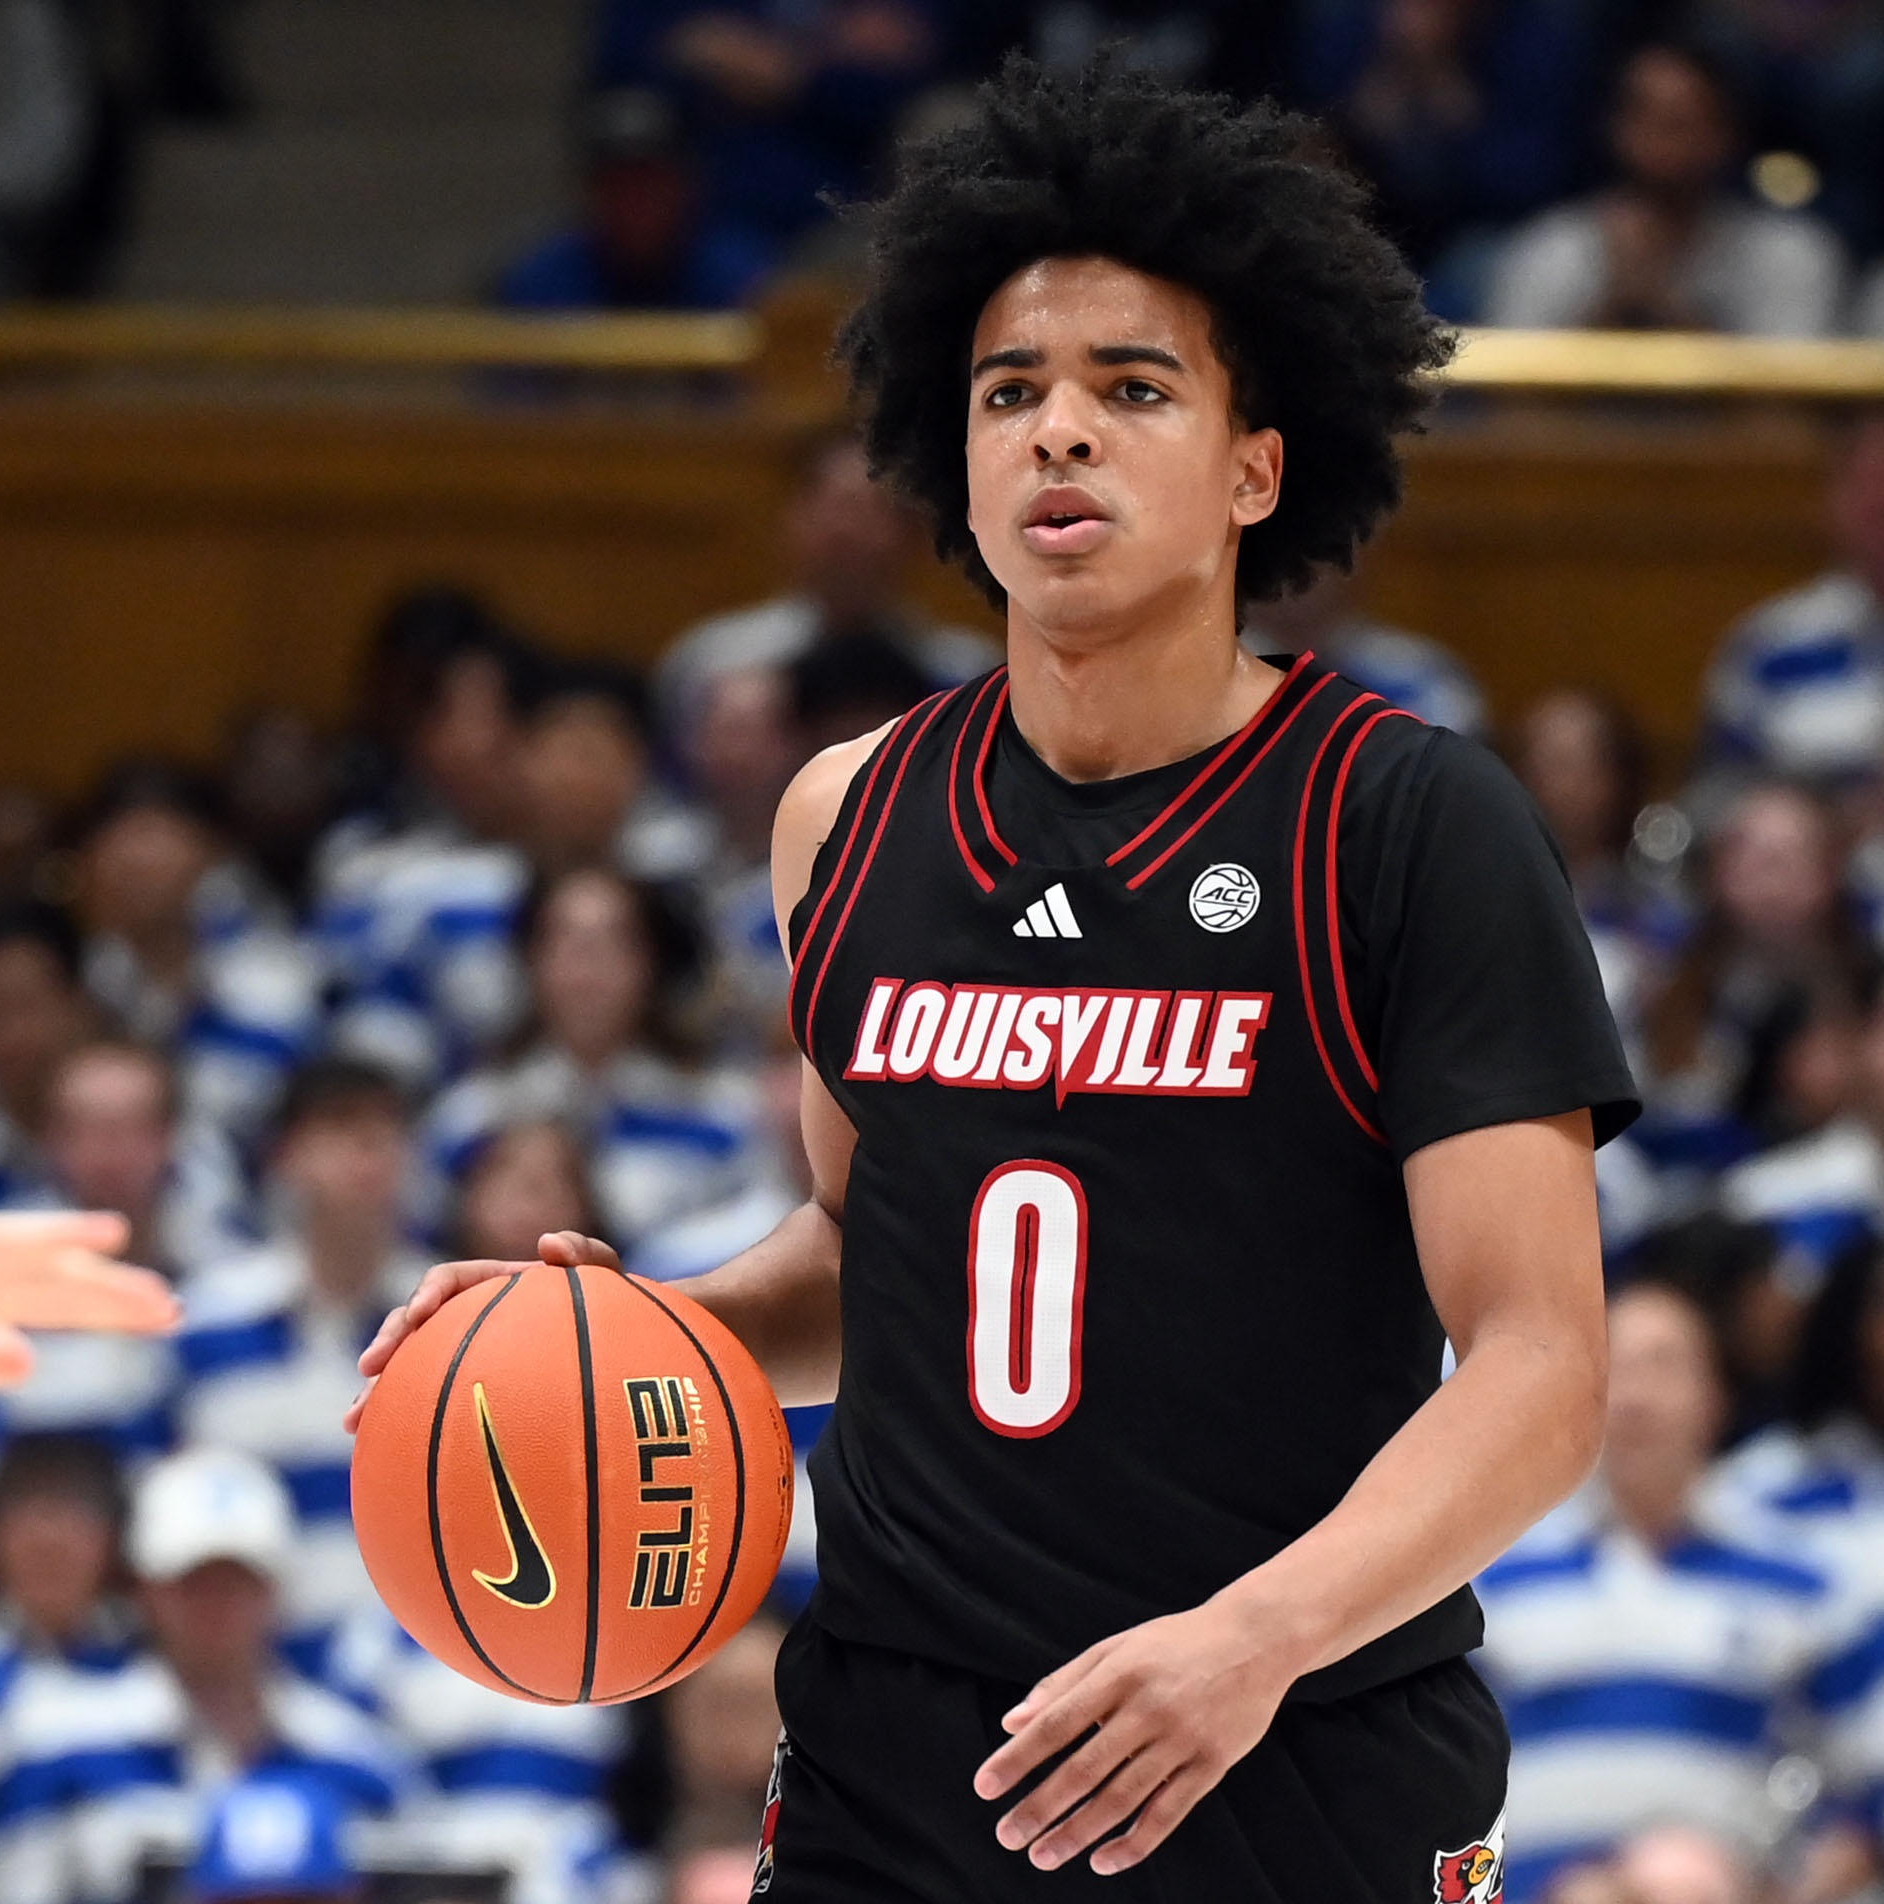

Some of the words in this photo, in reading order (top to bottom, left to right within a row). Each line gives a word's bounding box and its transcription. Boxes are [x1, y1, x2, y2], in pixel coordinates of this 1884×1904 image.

[1200, 886, 1256, 905] ACC
[843, 976, 1273, 1111] LOUISVILLE
[966, 1158, 1088, 1439] 0
[623, 1375, 694, 1610] ELITE
[683, 1376, 712, 1607] CHAMPINSHIP
